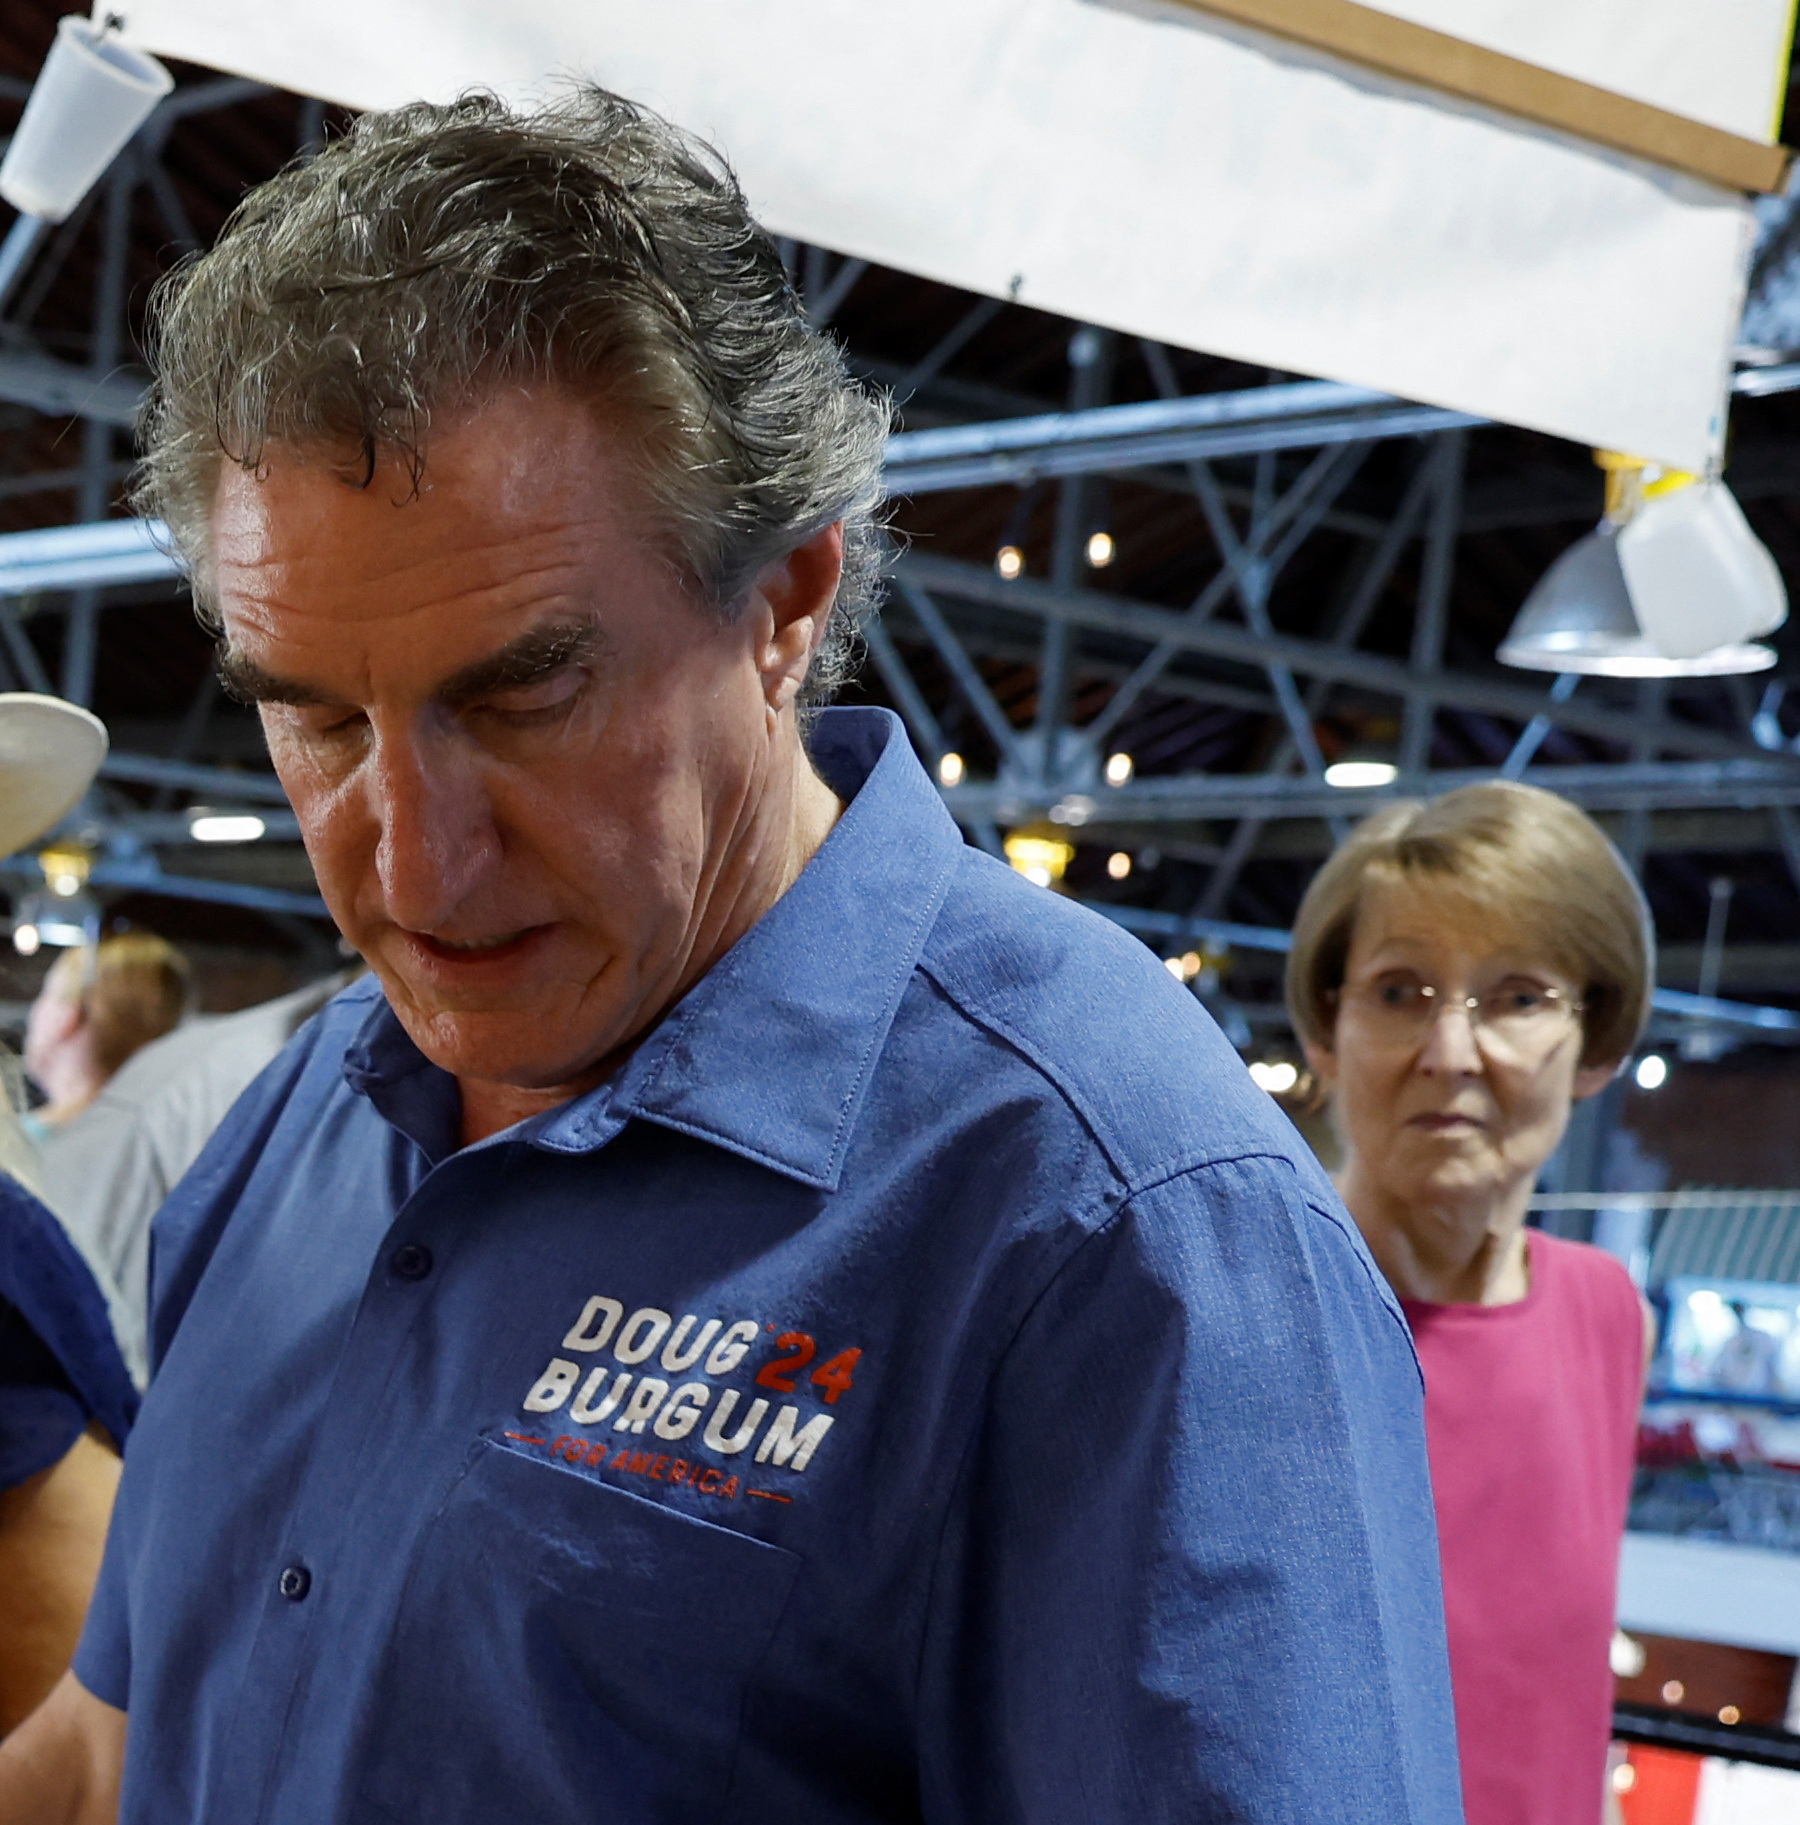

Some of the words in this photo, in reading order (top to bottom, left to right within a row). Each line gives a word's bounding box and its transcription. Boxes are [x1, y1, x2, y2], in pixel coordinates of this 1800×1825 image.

[561, 1294, 759, 1376] DOUG
[522, 1357, 835, 1473] BURGUM
[548, 1434, 608, 1469] FOR
[610, 1448, 740, 1498] AMERICA
